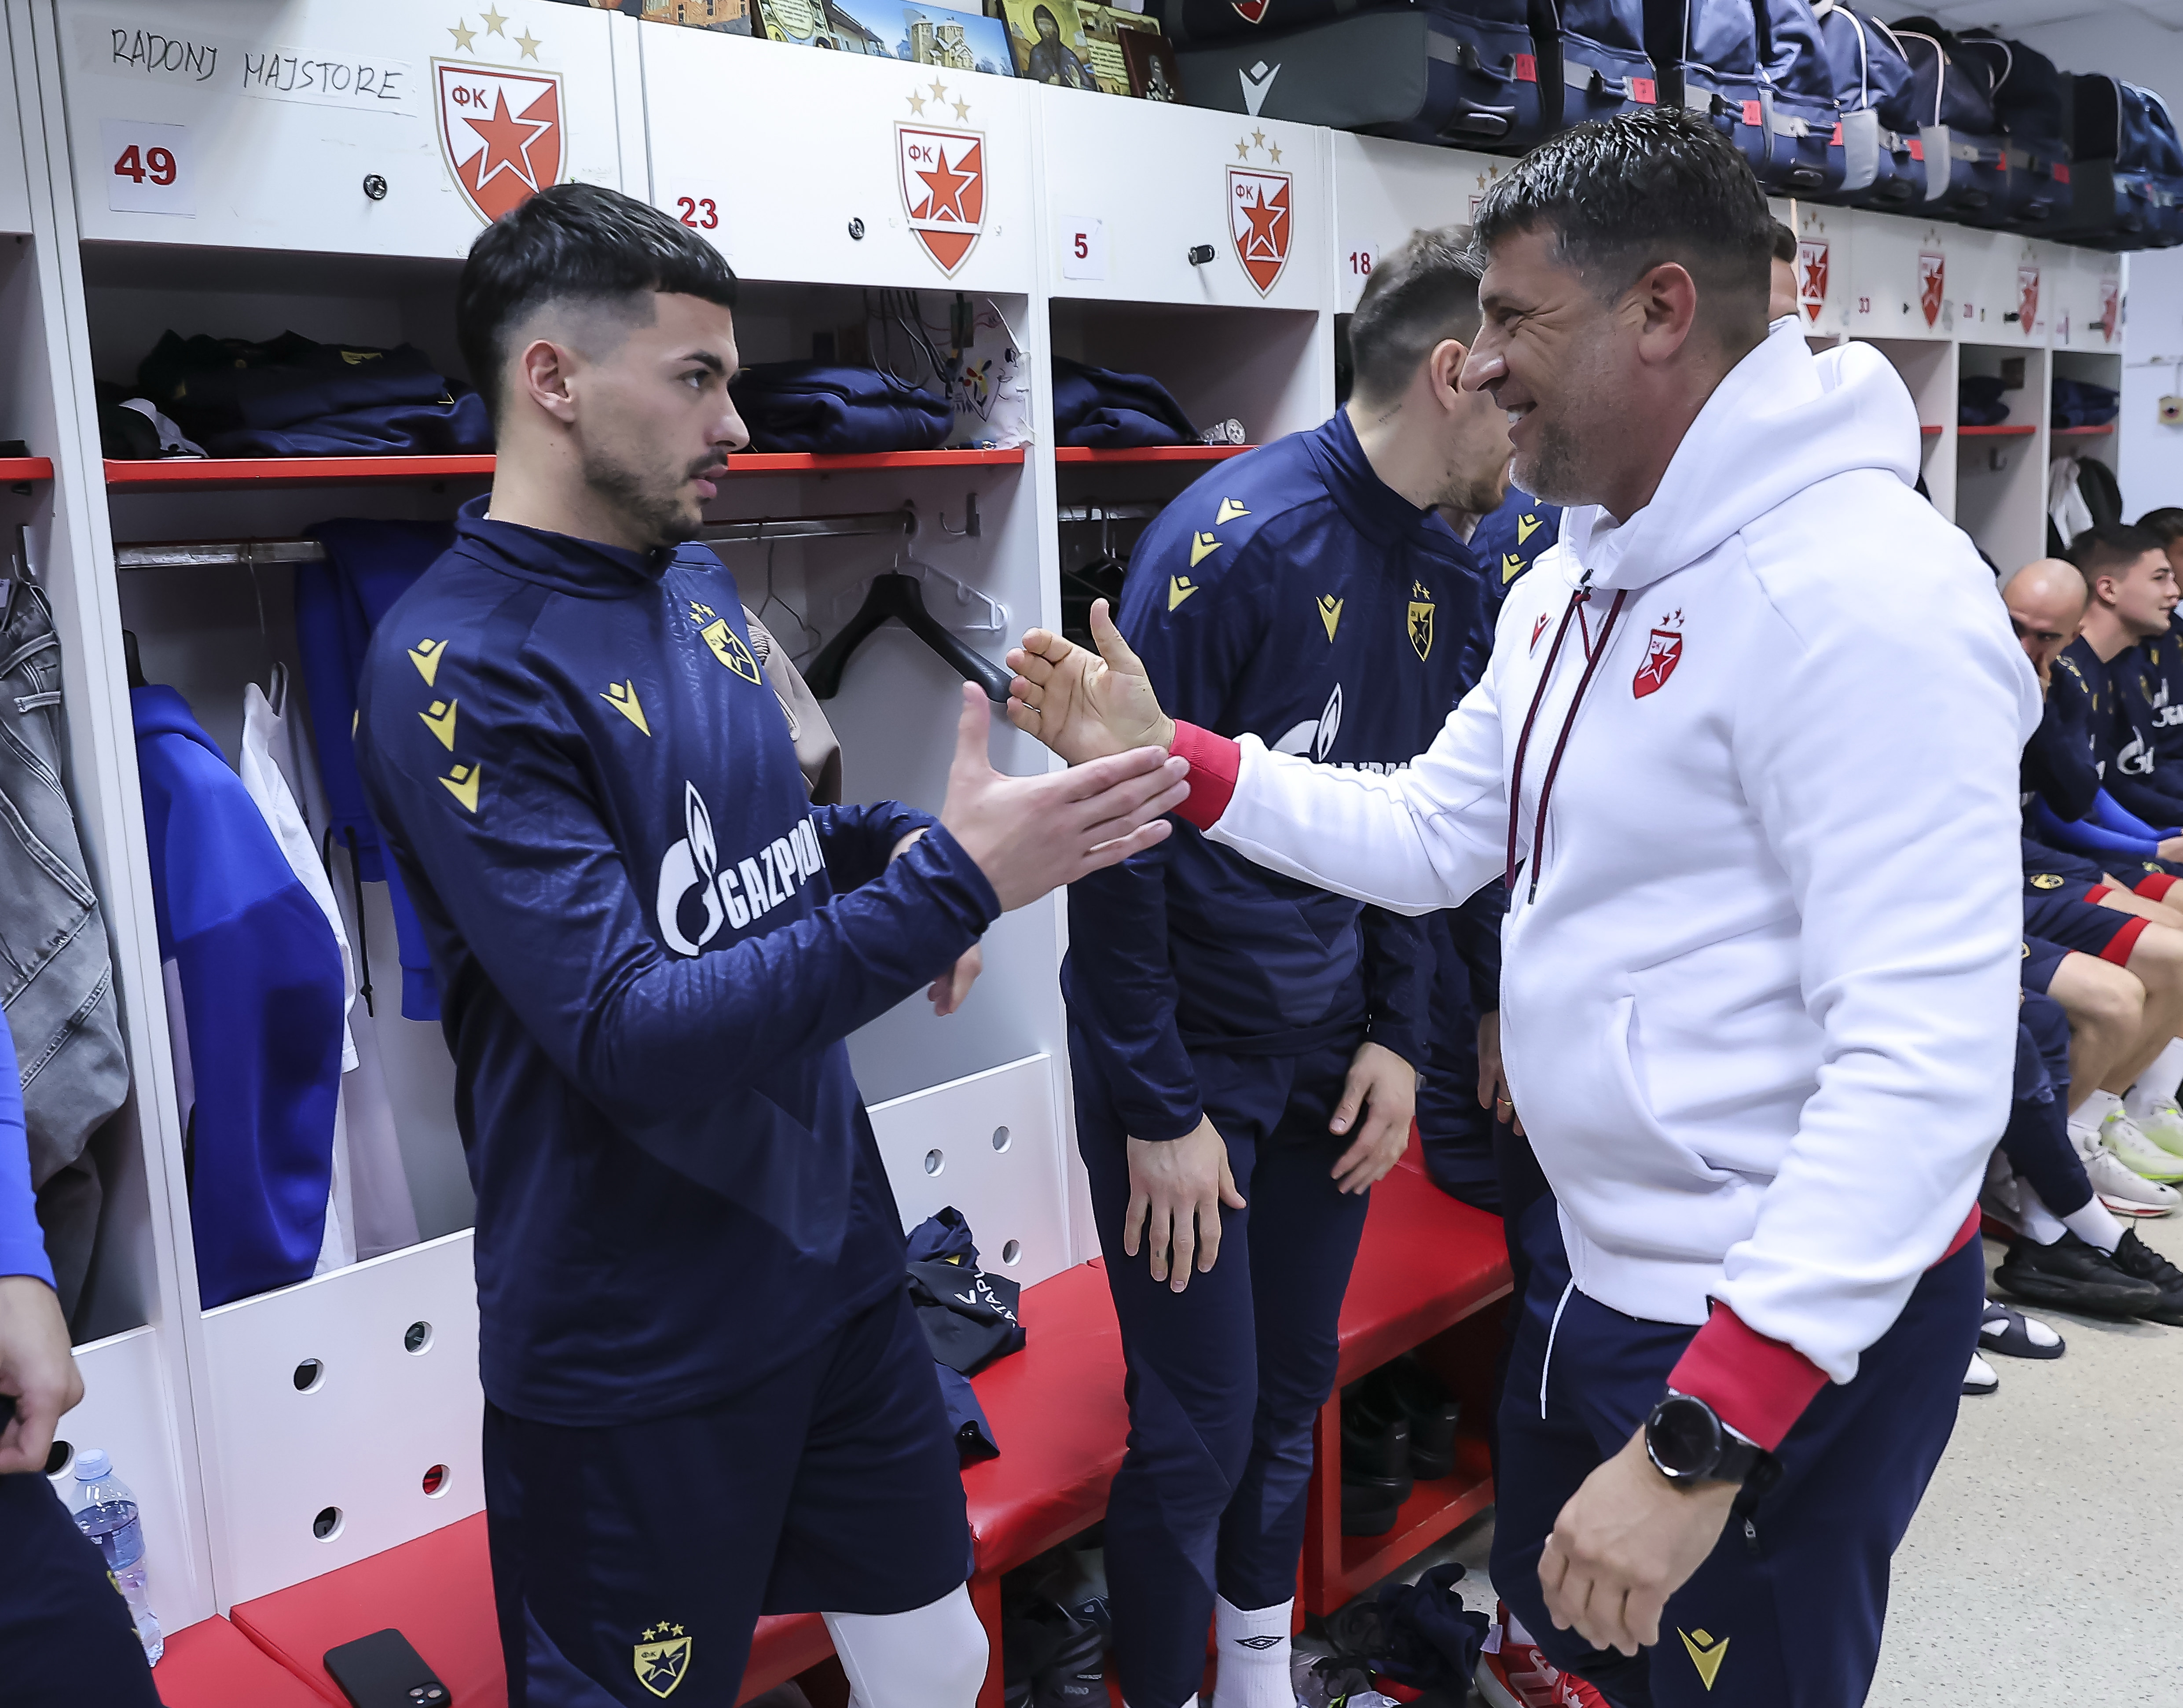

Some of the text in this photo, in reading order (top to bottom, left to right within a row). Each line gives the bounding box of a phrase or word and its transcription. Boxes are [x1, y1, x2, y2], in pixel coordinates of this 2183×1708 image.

[111, 28, 404, 99] RADONJ MAJSTORE
[451, 85, 488, 110] ФК
[114, 144, 177, 186] 49
[908, 144, 934, 164] ФК
[1235, 184, 1254, 201] ФК
[677, 196, 719, 229] 23
[1074, 233, 1089, 259] 5
[1349, 251, 1371, 275] 18
[717, 813, 826, 929] GAZPRO
